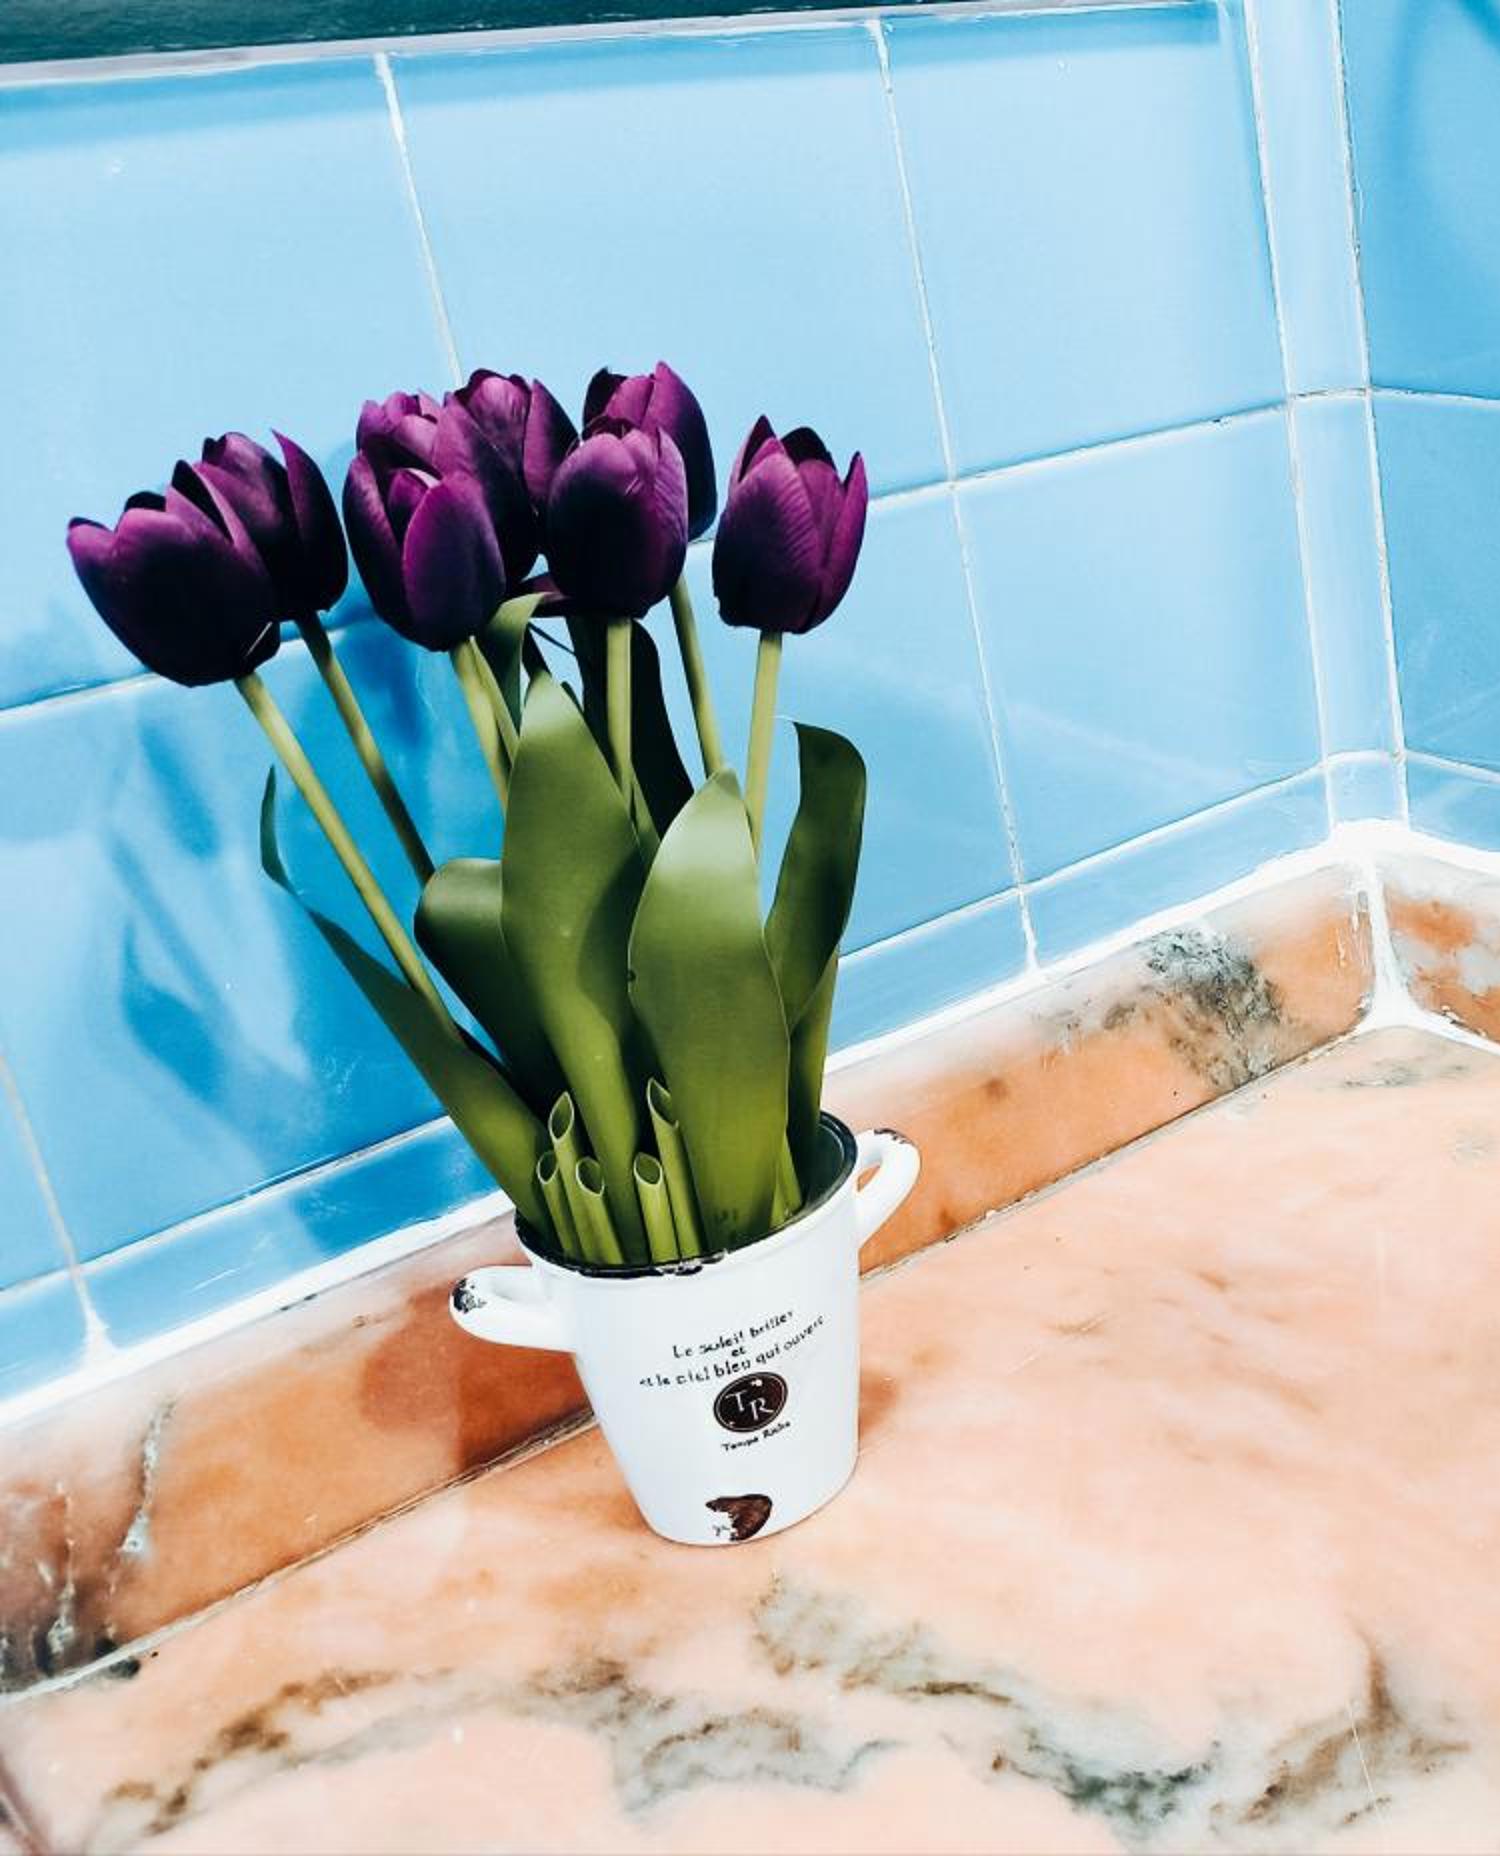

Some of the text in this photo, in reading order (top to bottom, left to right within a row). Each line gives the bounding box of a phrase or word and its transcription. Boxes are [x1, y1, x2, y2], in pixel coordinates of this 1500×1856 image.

[713, 1359, 752, 1378] bleu
[755, 1343, 781, 1365] qui
[731, 1346, 748, 1358] et
